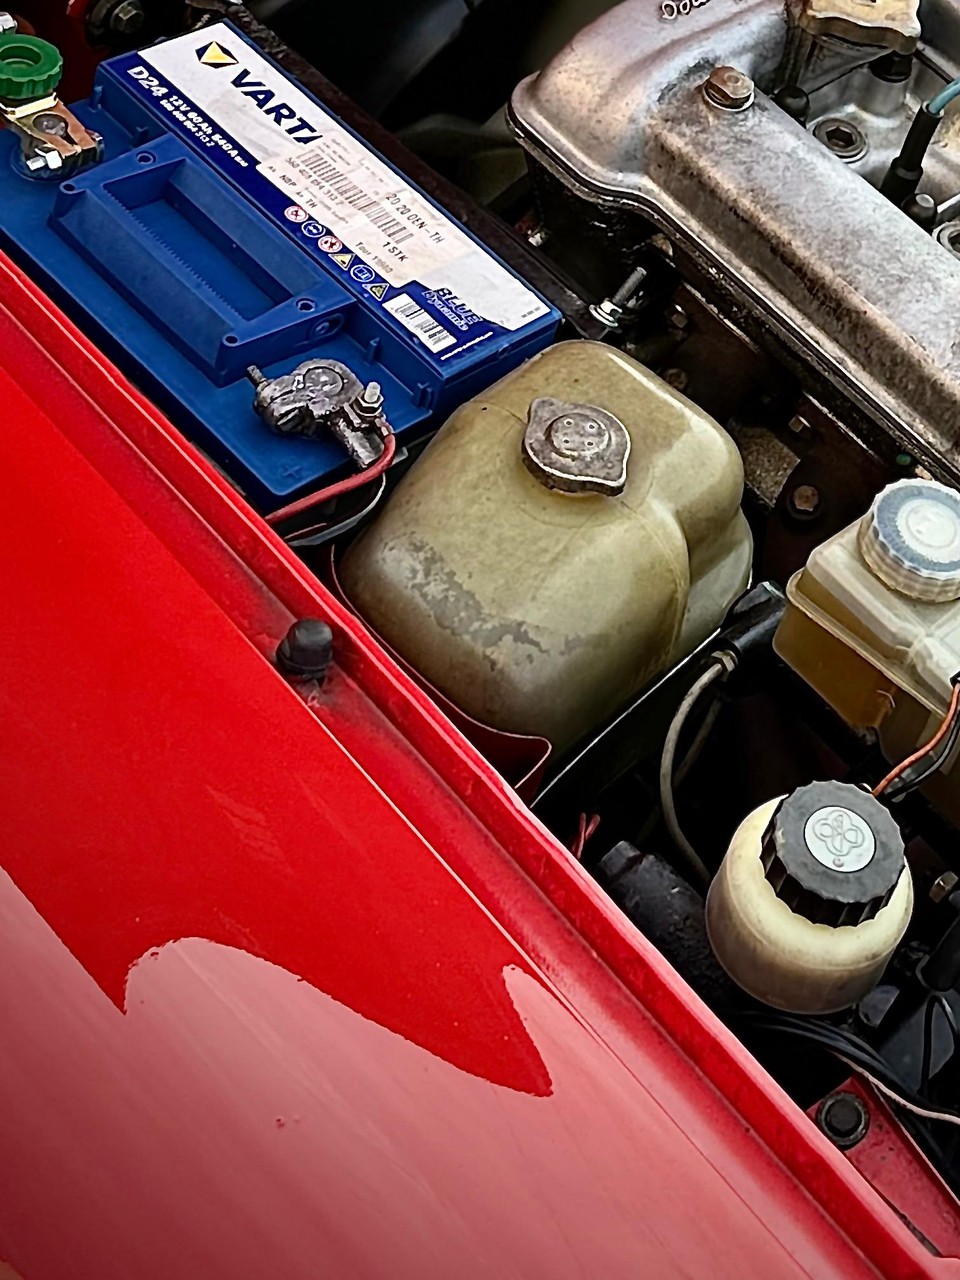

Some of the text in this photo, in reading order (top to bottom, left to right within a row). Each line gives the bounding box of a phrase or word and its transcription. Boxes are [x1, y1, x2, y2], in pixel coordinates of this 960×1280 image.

[126, 66, 169, 97] D24
[169, 95, 191, 111] 12V
[396, 205, 411, 215] 20
[388, 246, 408, 262] STK
[434, 287, 483, 325] BLUE
